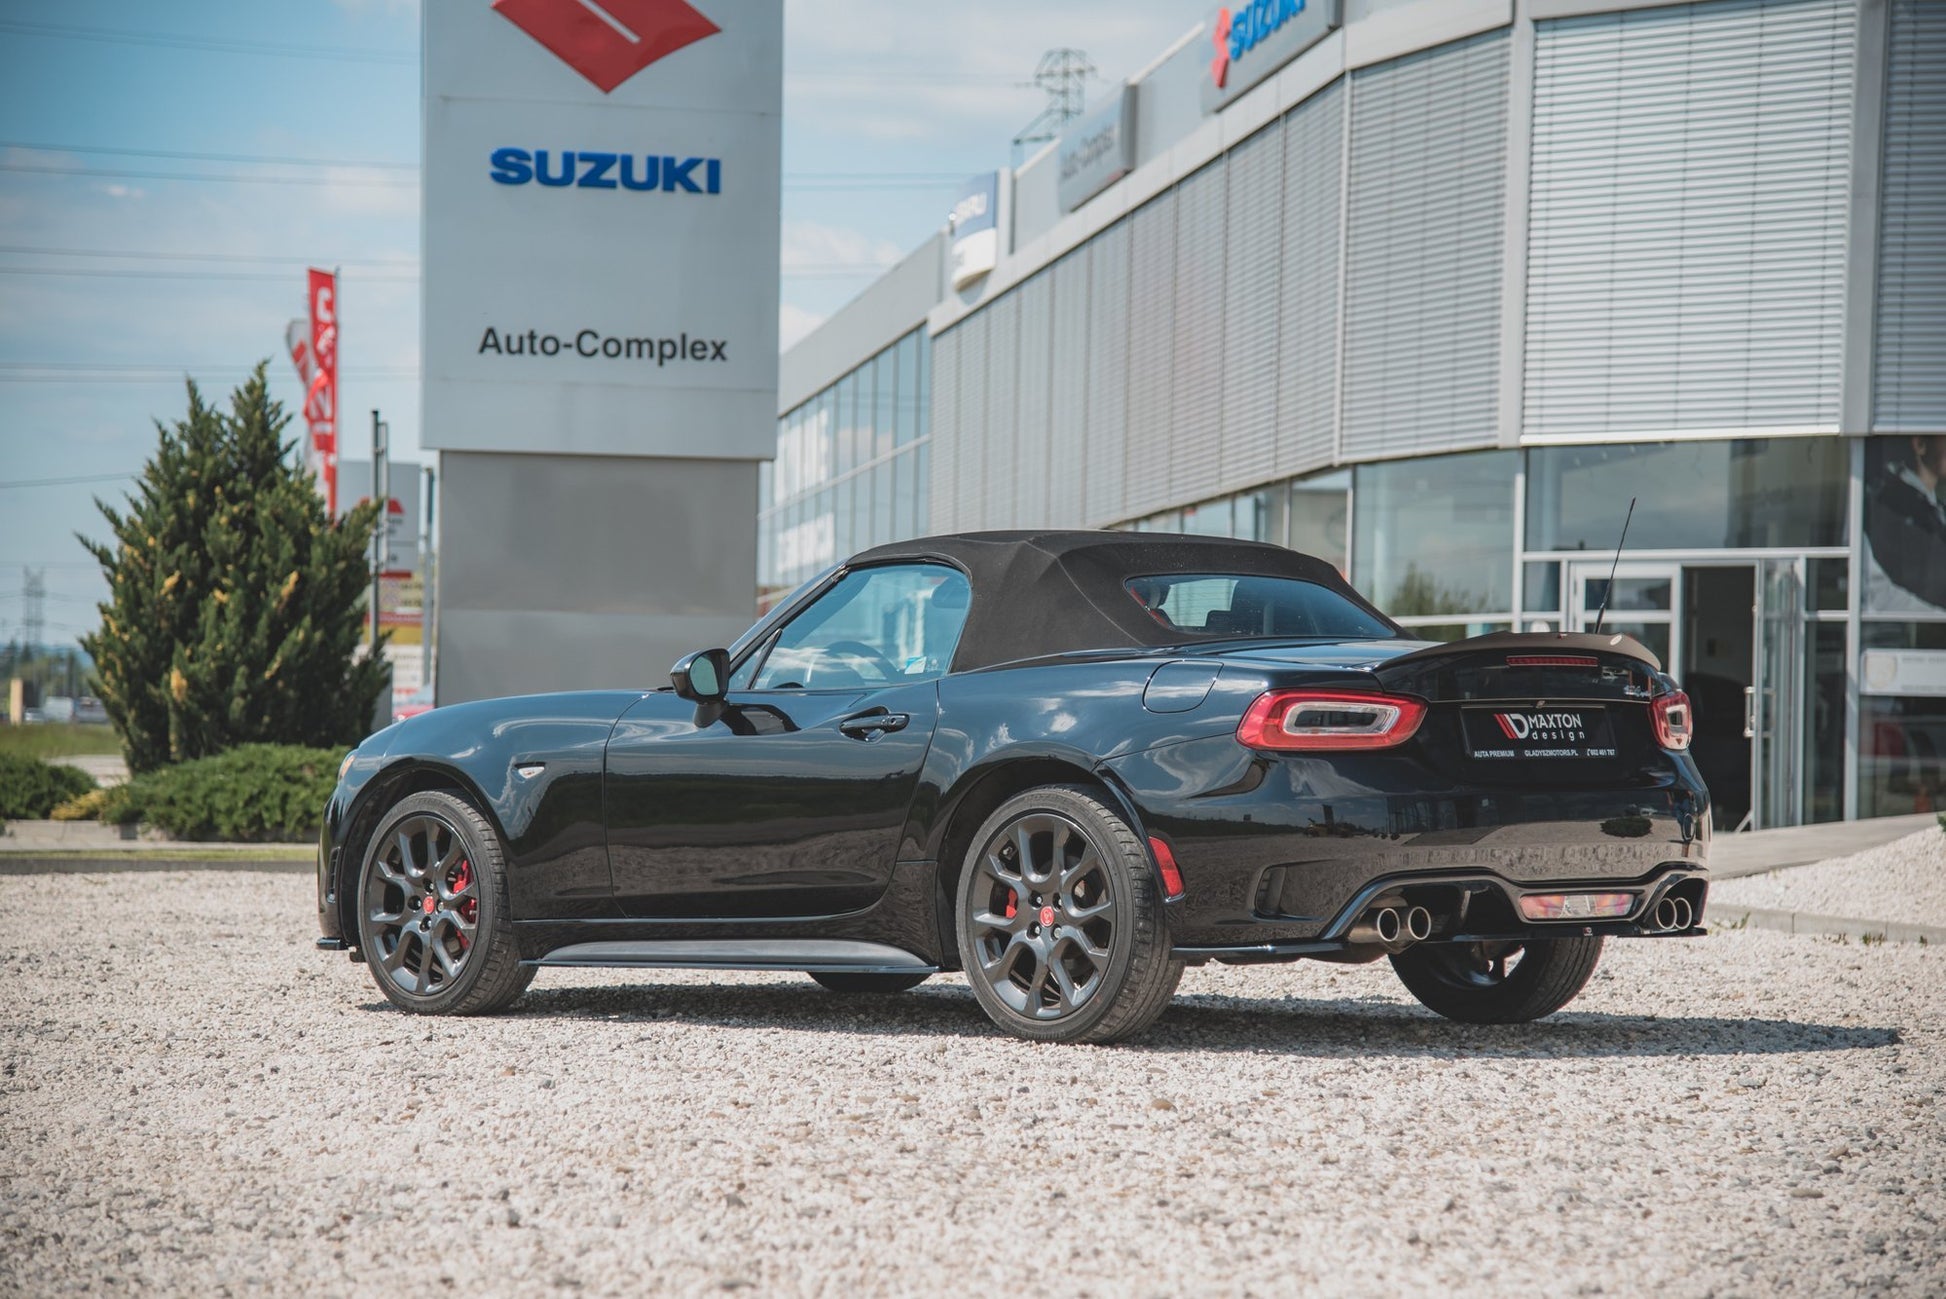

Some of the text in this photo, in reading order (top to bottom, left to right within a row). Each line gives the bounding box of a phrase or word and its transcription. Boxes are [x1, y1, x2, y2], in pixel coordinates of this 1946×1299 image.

[1231, 0, 1306, 61] SUZU
[490, 147, 721, 195] SUZUKI
[478, 326, 728, 367] Auto-Complex
[1528, 713, 1583, 729] MAXTON
[1532, 730, 1585, 742] design
